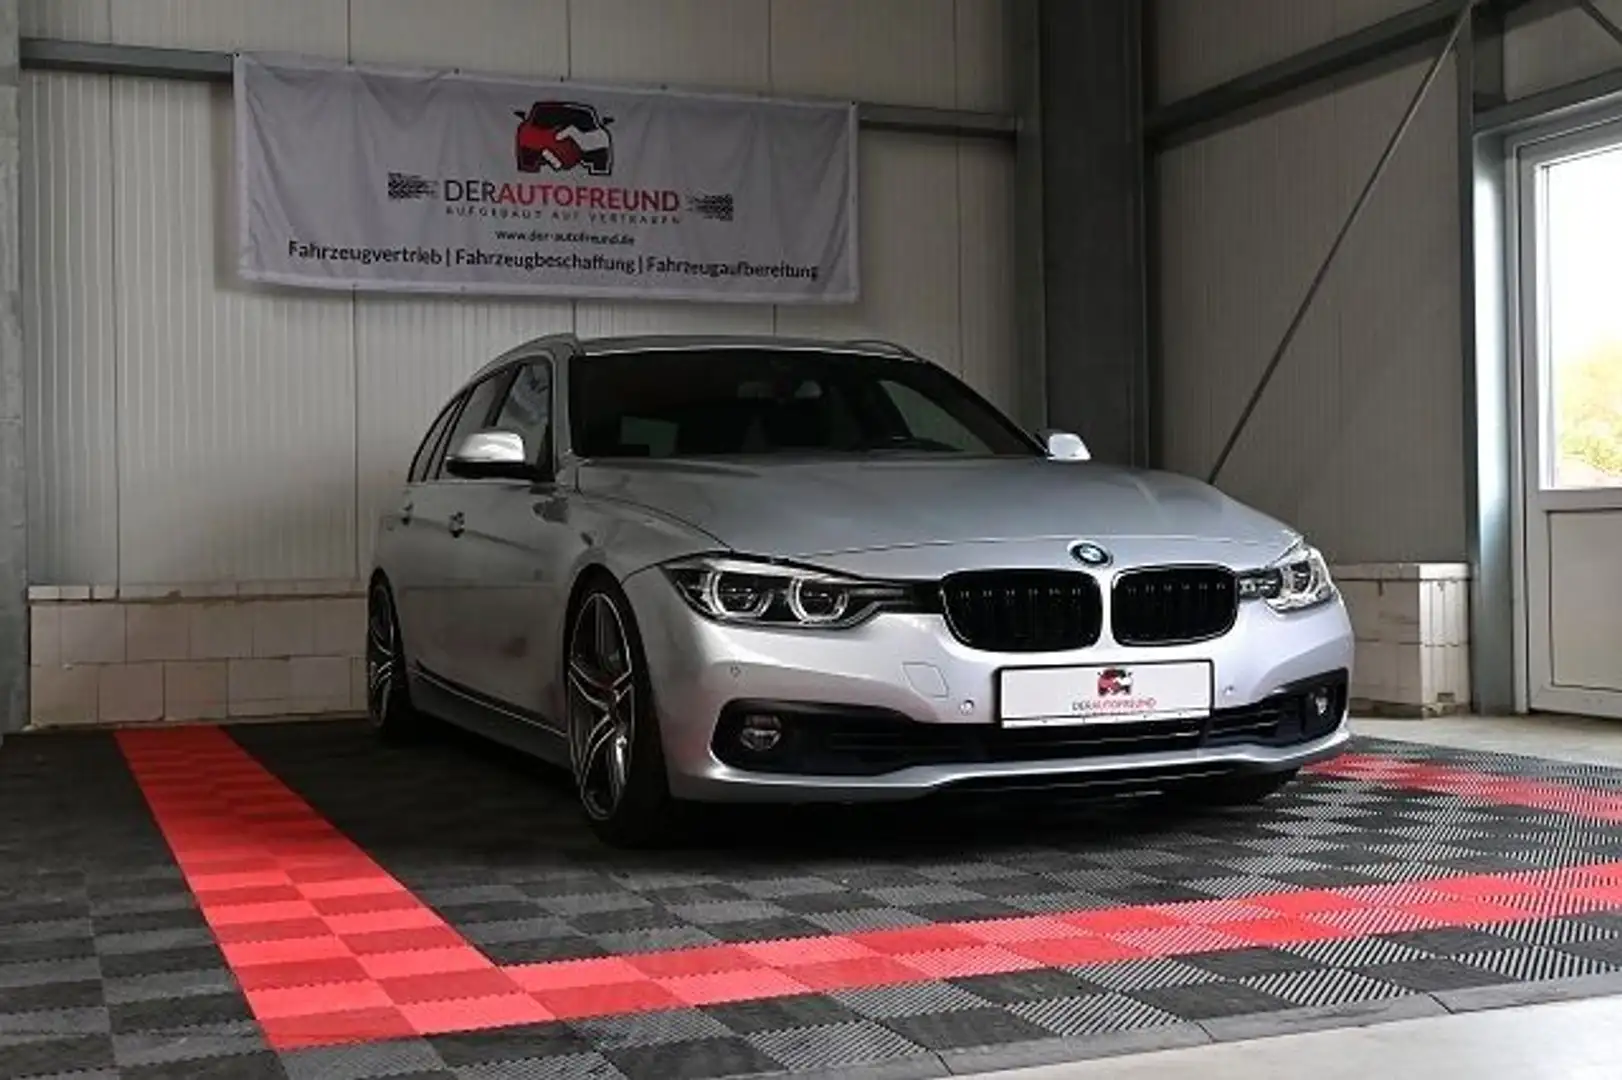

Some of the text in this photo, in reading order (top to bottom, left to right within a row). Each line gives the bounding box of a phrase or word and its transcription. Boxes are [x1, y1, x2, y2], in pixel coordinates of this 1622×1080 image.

[444, 180, 681, 212] DERAUTOFREUND
[495, 229, 635, 245] www.der-autofreund.de
[288, 240, 818, 281] Fahrzeugvertrieb Fahrzeugbeschaffung Fahrzeugaufbereitung
